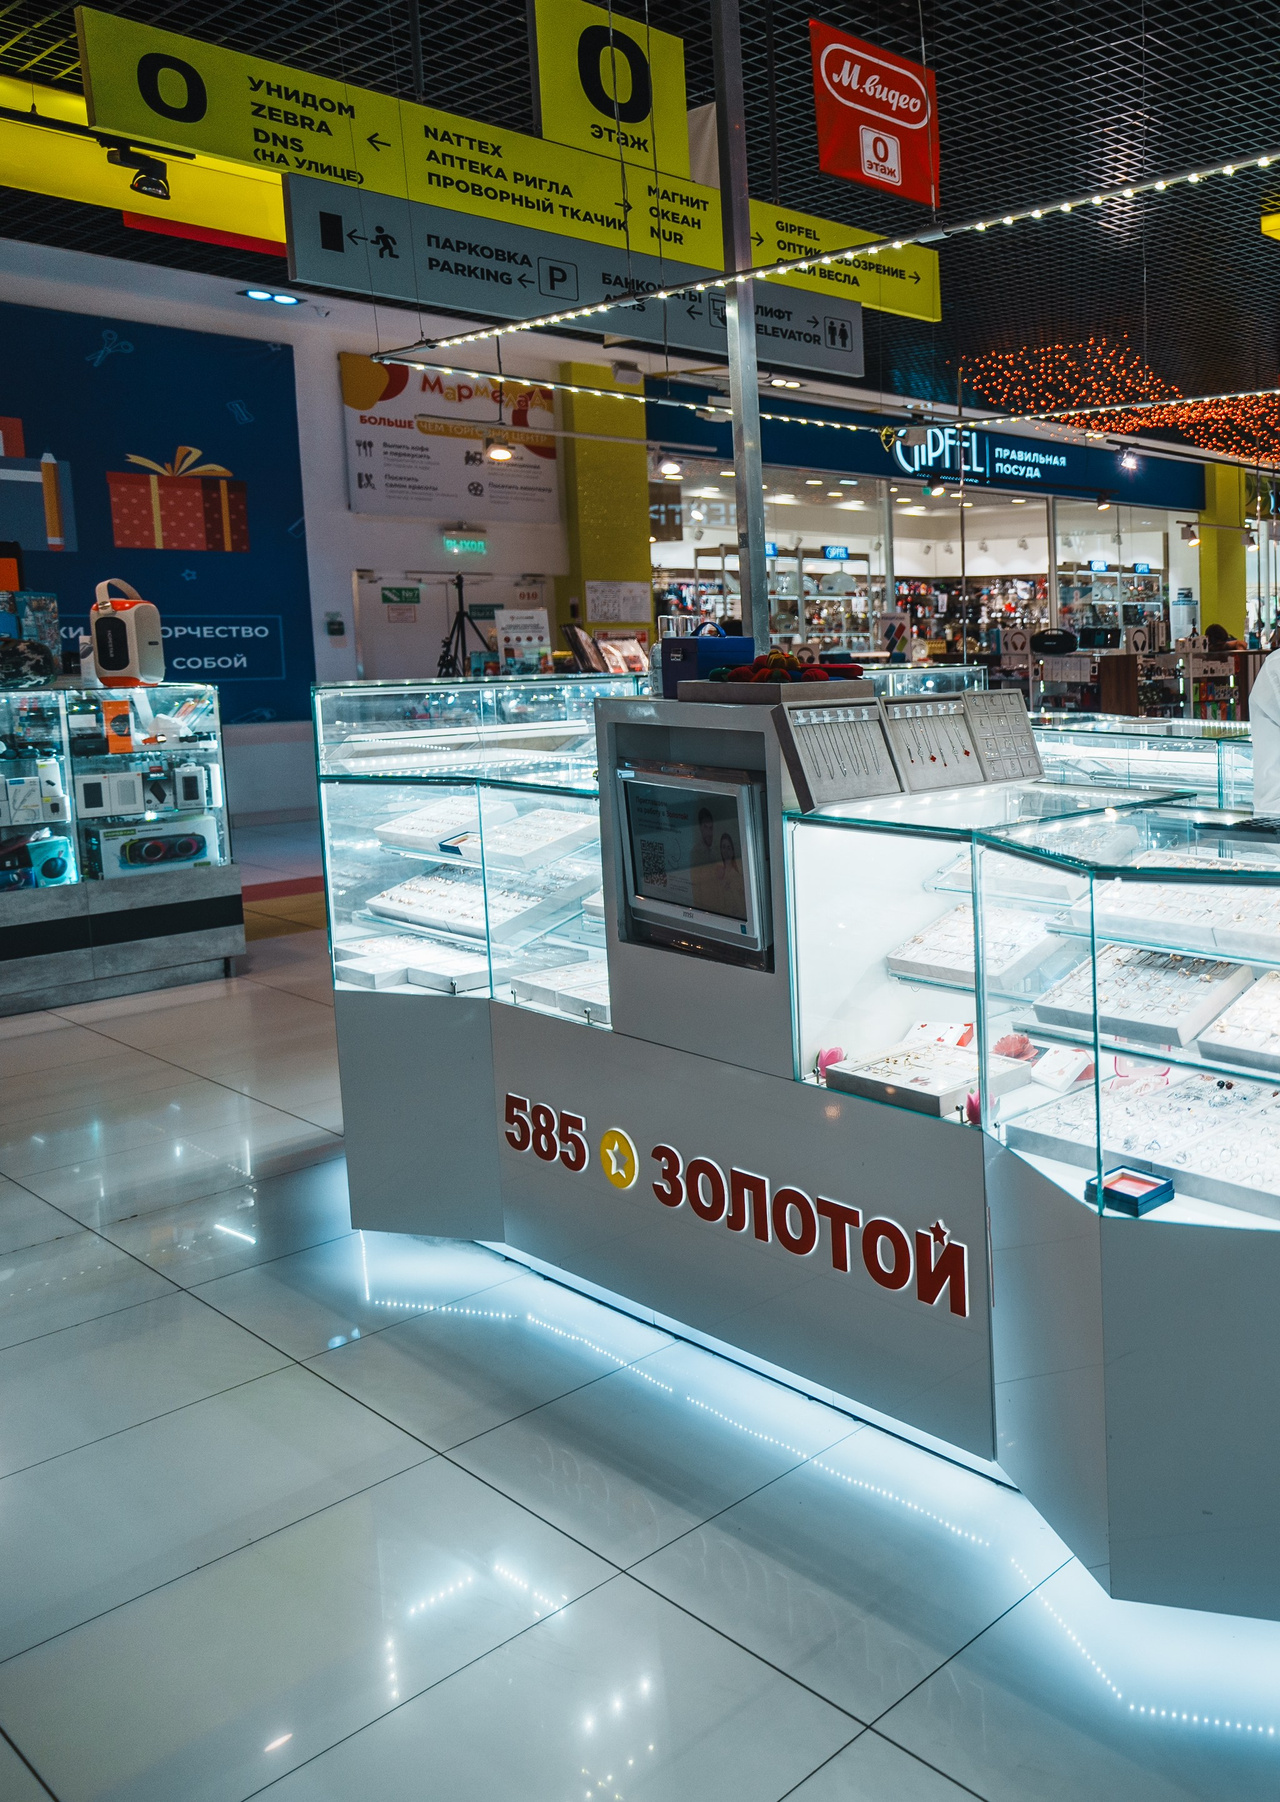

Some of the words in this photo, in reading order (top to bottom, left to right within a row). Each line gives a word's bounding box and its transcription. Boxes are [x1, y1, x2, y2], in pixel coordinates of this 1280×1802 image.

[247, 76, 355, 119] УНИДОМ
[251, 101, 333, 137] ZEBRA
[253, 127, 304, 153] DNS
[424, 125, 503, 158] NATTEX
[590, 124, 650, 153] этаж
[253, 147, 290, 167] (НА
[295, 157, 365, 185] УЛИЦЕ)
[426, 149, 508, 182] АПТЕКА
[513, 171, 573, 198] РИГЛА
[866, 159, 897, 179] этаж
[427, 172, 554, 214] ПРОВОРНЫЙ
[559, 204, 628, 232] ТКАЧИК
[647, 185, 709, 212] МАГНИТ
[649, 206, 701, 230] ОКЕАН
[650, 226, 684, 245] NUR
[775, 220, 821, 241] GIPFEL
[426, 233, 533, 268] ПАРКОВКА
[776, 240, 829, 258] ОПТИК
[428, 257, 513, 285] PARKING
[819, 267, 860, 287] ВЕСЛА
[755, 304, 793, 322] ЛИФТ
[756, 323, 821, 346] ELEVATOR
[359, 415, 414, 430] БОЛЬШЕ
[995, 447, 1067, 467] ПРАВИЛЬНАЯ
[995, 463, 1041, 479] ПОСУДА
[161, 626, 270, 639] ОРЧЕСТВО
[172, 653, 248, 669] СОБОЙ
[505, 1092, 590, 1173] 585
[650, 1143, 969, 1318] ЗОЛОТОЙ
